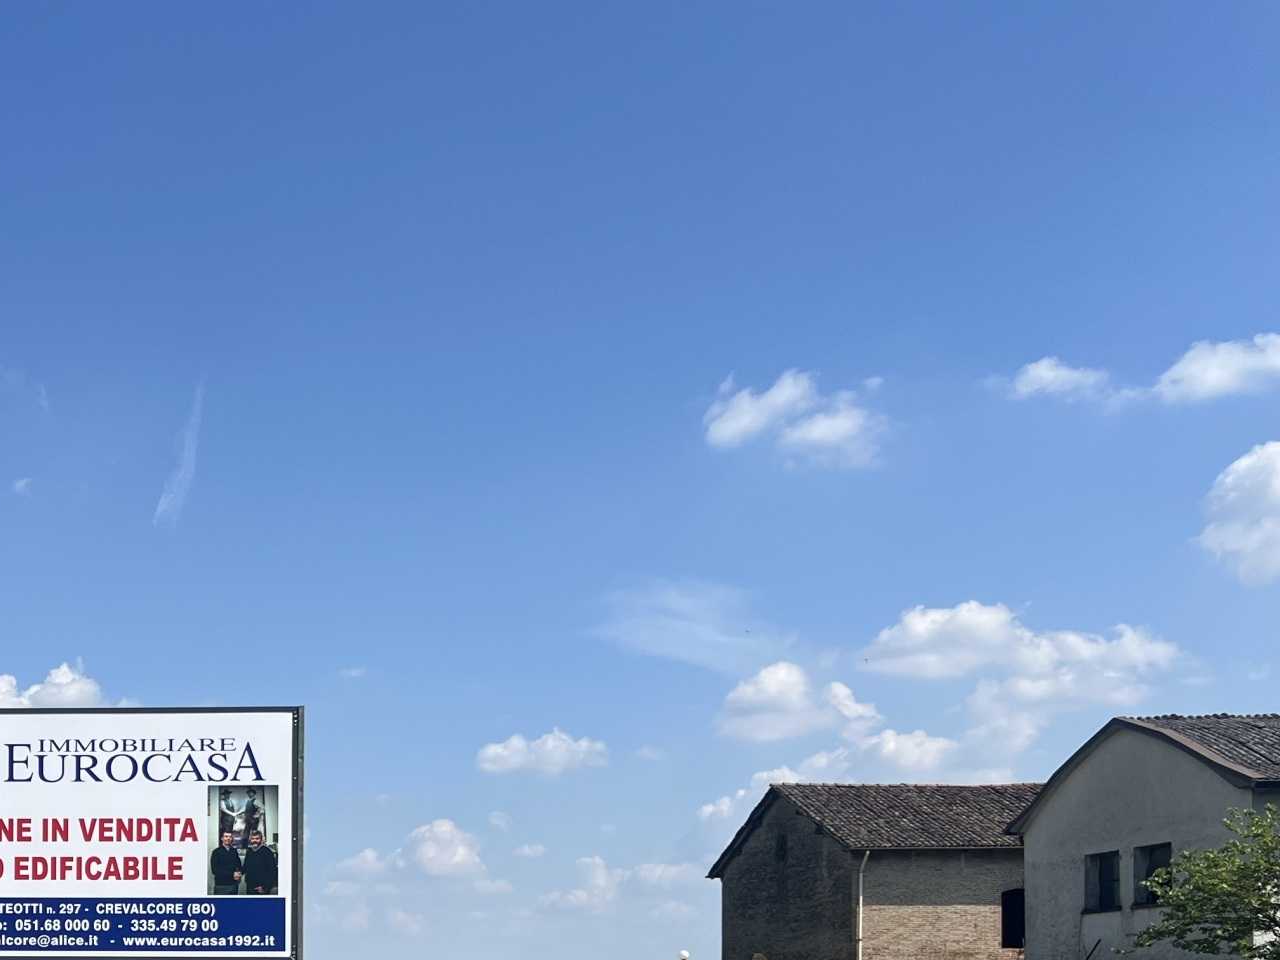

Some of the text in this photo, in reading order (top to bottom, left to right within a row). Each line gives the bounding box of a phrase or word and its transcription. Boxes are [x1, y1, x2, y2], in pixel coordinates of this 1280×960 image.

[38, 738, 237, 753] IMMOBILIARE
[3, 741, 267, 784] EUROCASA
[42, 817, 69, 843] IN
[79, 817, 199, 843] VENDITA
[14, 856, 184, 881] EDIFICABILE
[46, 906, 56, 914] n.
[58, 903, 82, 915] 297
[95, 903, 184, 915] CREVALCORE
[186, 903, 216, 917] (BO)
[14, 919, 61, 932] 051.68
[64, 919, 90, 932] 000
[93, 919, 110, 932] 60
[130, 919, 177, 932] 335.49
[180, 919, 198, 932] 79
[201, 919, 219, 932] 00
[122, 935, 275, 947] www.eurocasa1992.it
